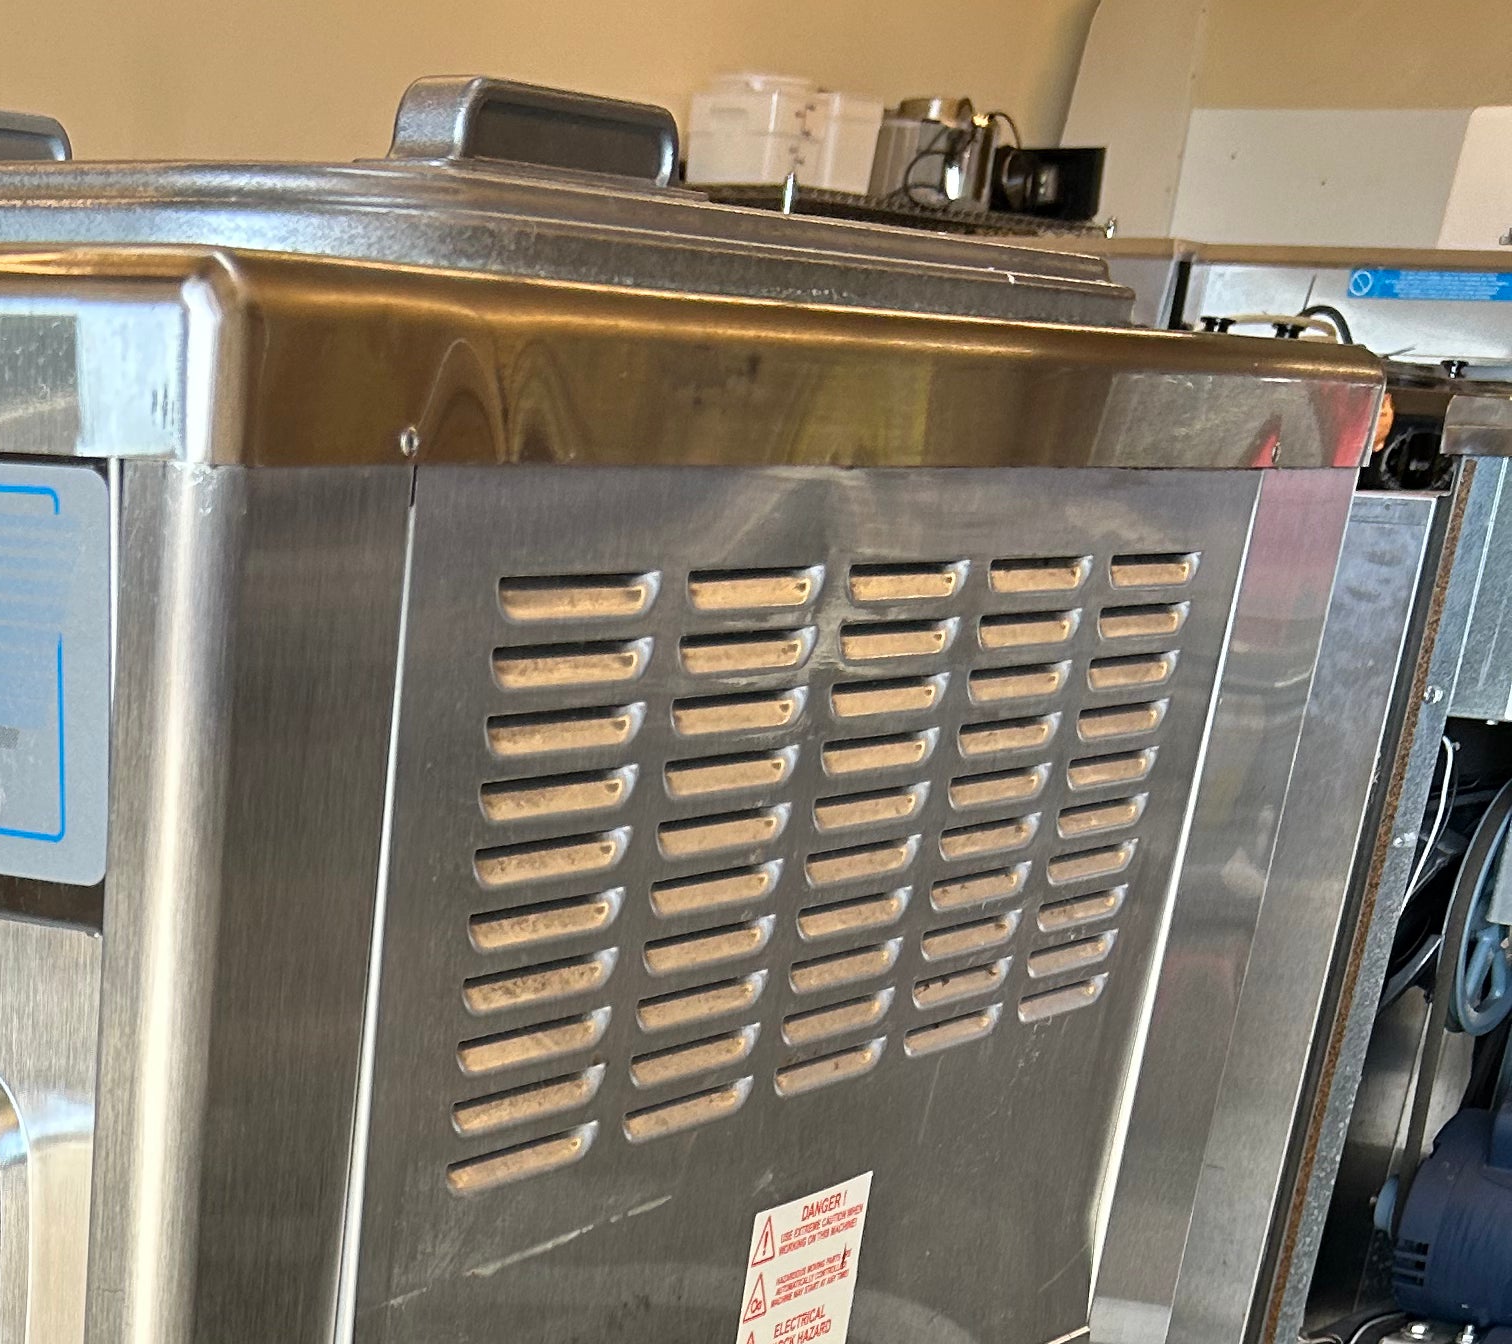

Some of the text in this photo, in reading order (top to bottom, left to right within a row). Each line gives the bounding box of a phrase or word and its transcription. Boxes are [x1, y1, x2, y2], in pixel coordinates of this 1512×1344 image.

[802, 1193, 841, 1221] DANGER
[774, 1306, 825, 1338] ELECTRICAL
[797, 1319, 831, 1344] HAZARD
